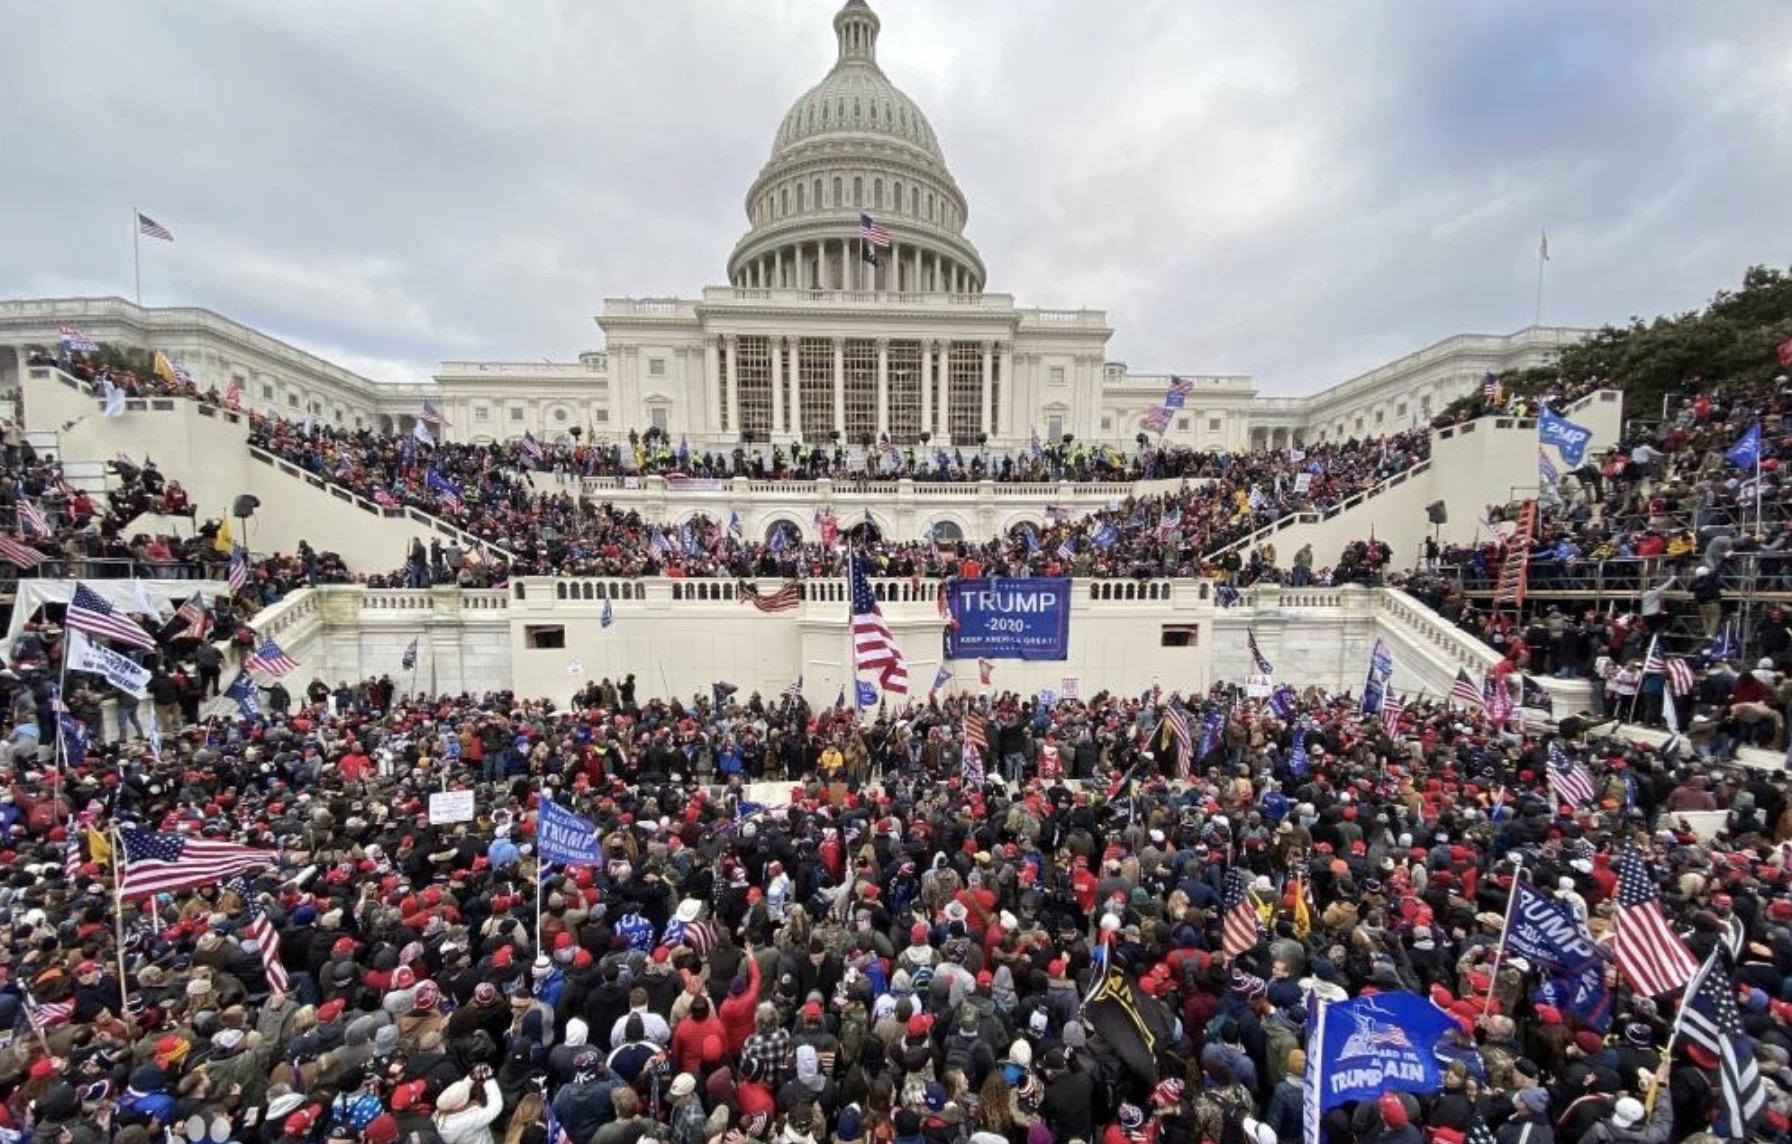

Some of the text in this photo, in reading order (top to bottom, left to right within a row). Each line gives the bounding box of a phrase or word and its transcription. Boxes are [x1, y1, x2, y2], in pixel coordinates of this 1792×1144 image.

[960, 591, 1056, 612] TRUMP
[543, 820, 594, 850] TRUMP
[1519, 887, 1594, 957] RUMP
[1330, 1060, 1425, 1094] TRUMP AIN
